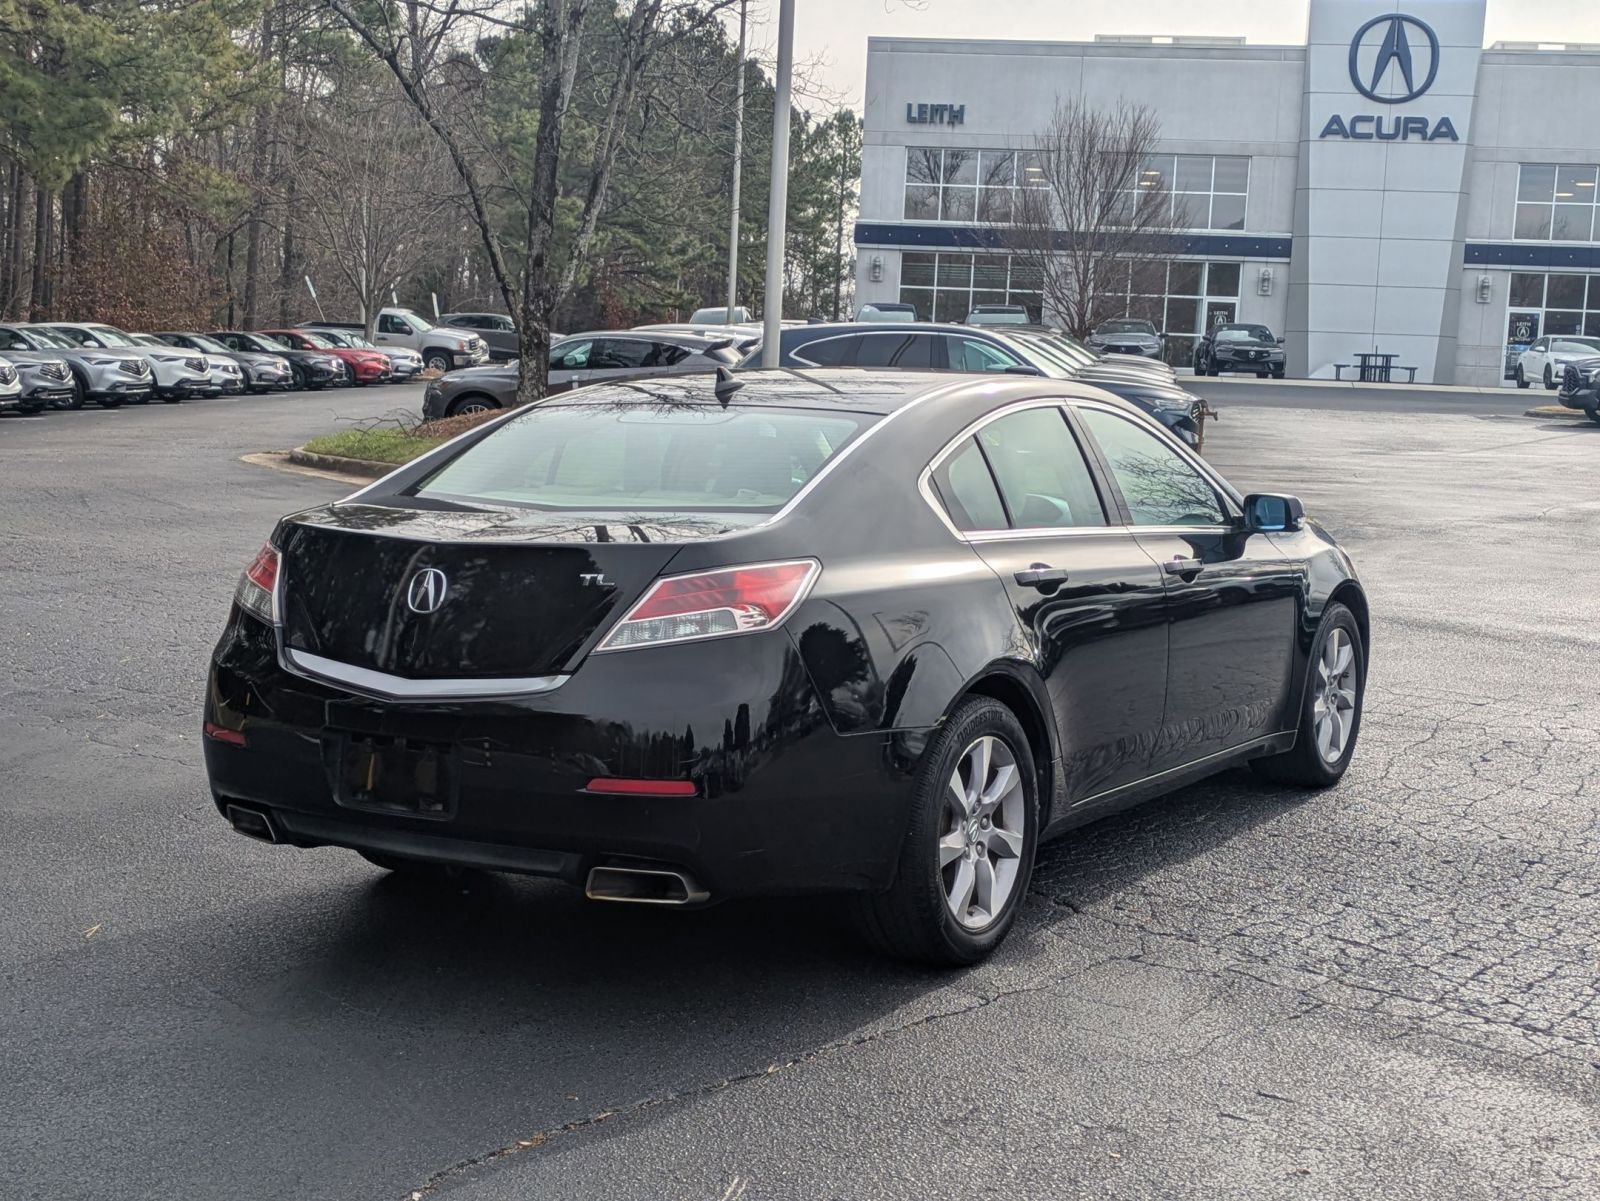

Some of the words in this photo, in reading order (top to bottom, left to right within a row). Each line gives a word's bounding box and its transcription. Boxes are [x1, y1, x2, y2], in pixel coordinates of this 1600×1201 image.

[907, 103, 965, 125] LEITH
[1319, 114, 1460, 141] ACURA
[579, 574, 615, 586] TL
